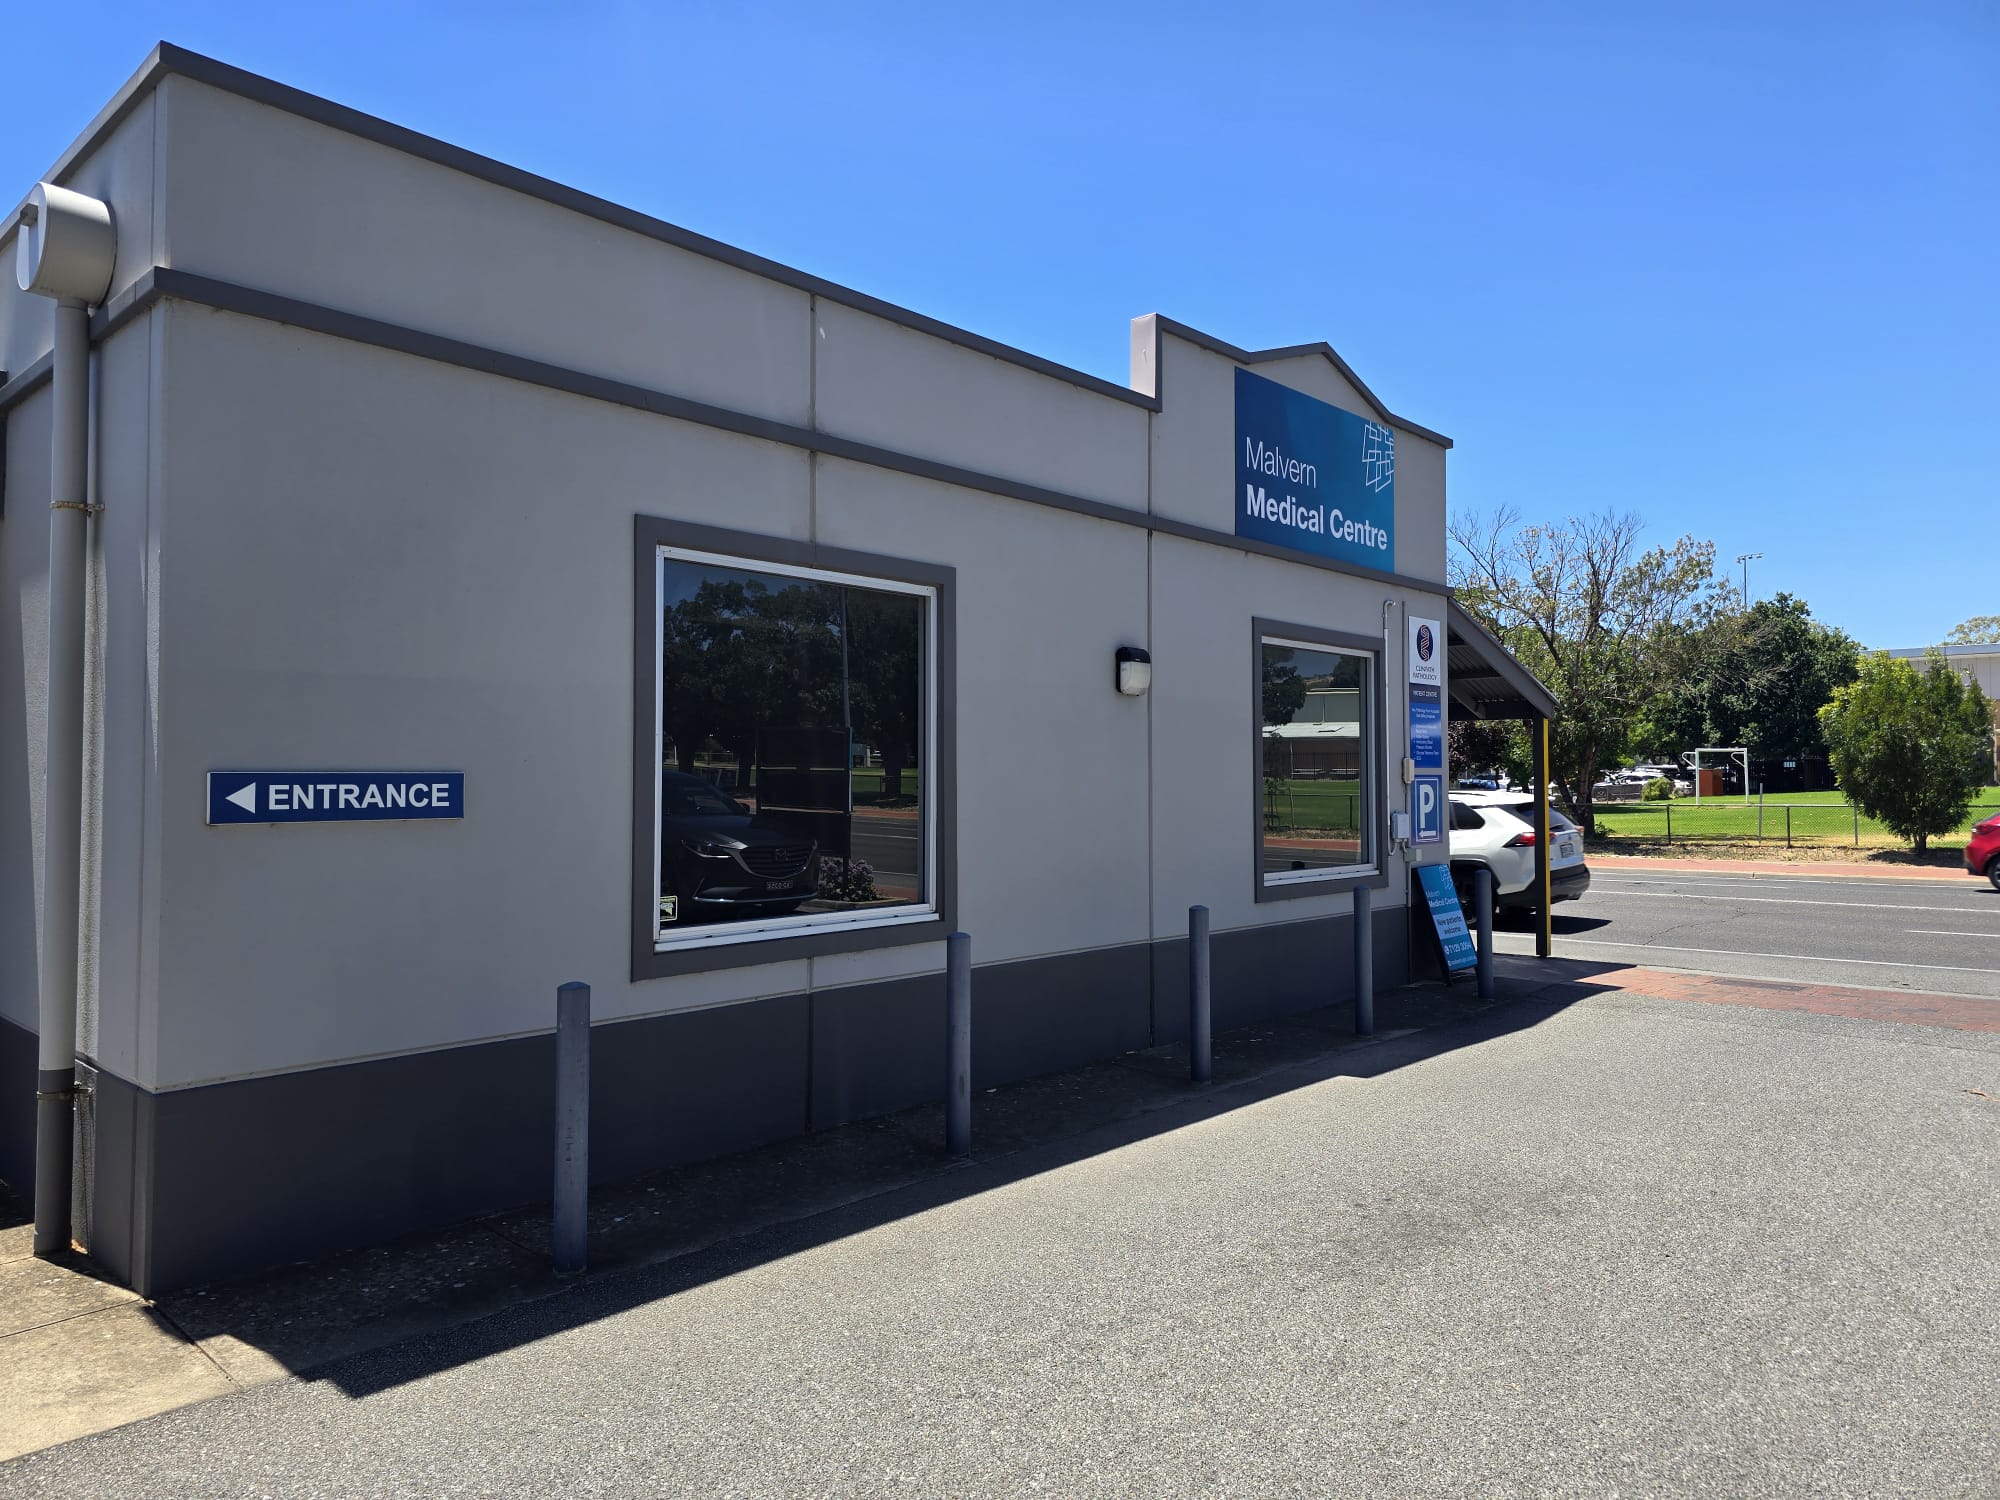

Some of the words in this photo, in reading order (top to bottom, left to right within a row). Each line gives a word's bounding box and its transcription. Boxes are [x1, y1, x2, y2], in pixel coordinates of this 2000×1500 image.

[1246, 437, 1317, 488] Malvern
[1246, 483, 1324, 535] Medical
[1330, 508, 1388, 551] Centre
[269, 783, 450, 810] ENTRANCE
[1419, 784, 1435, 829] P
